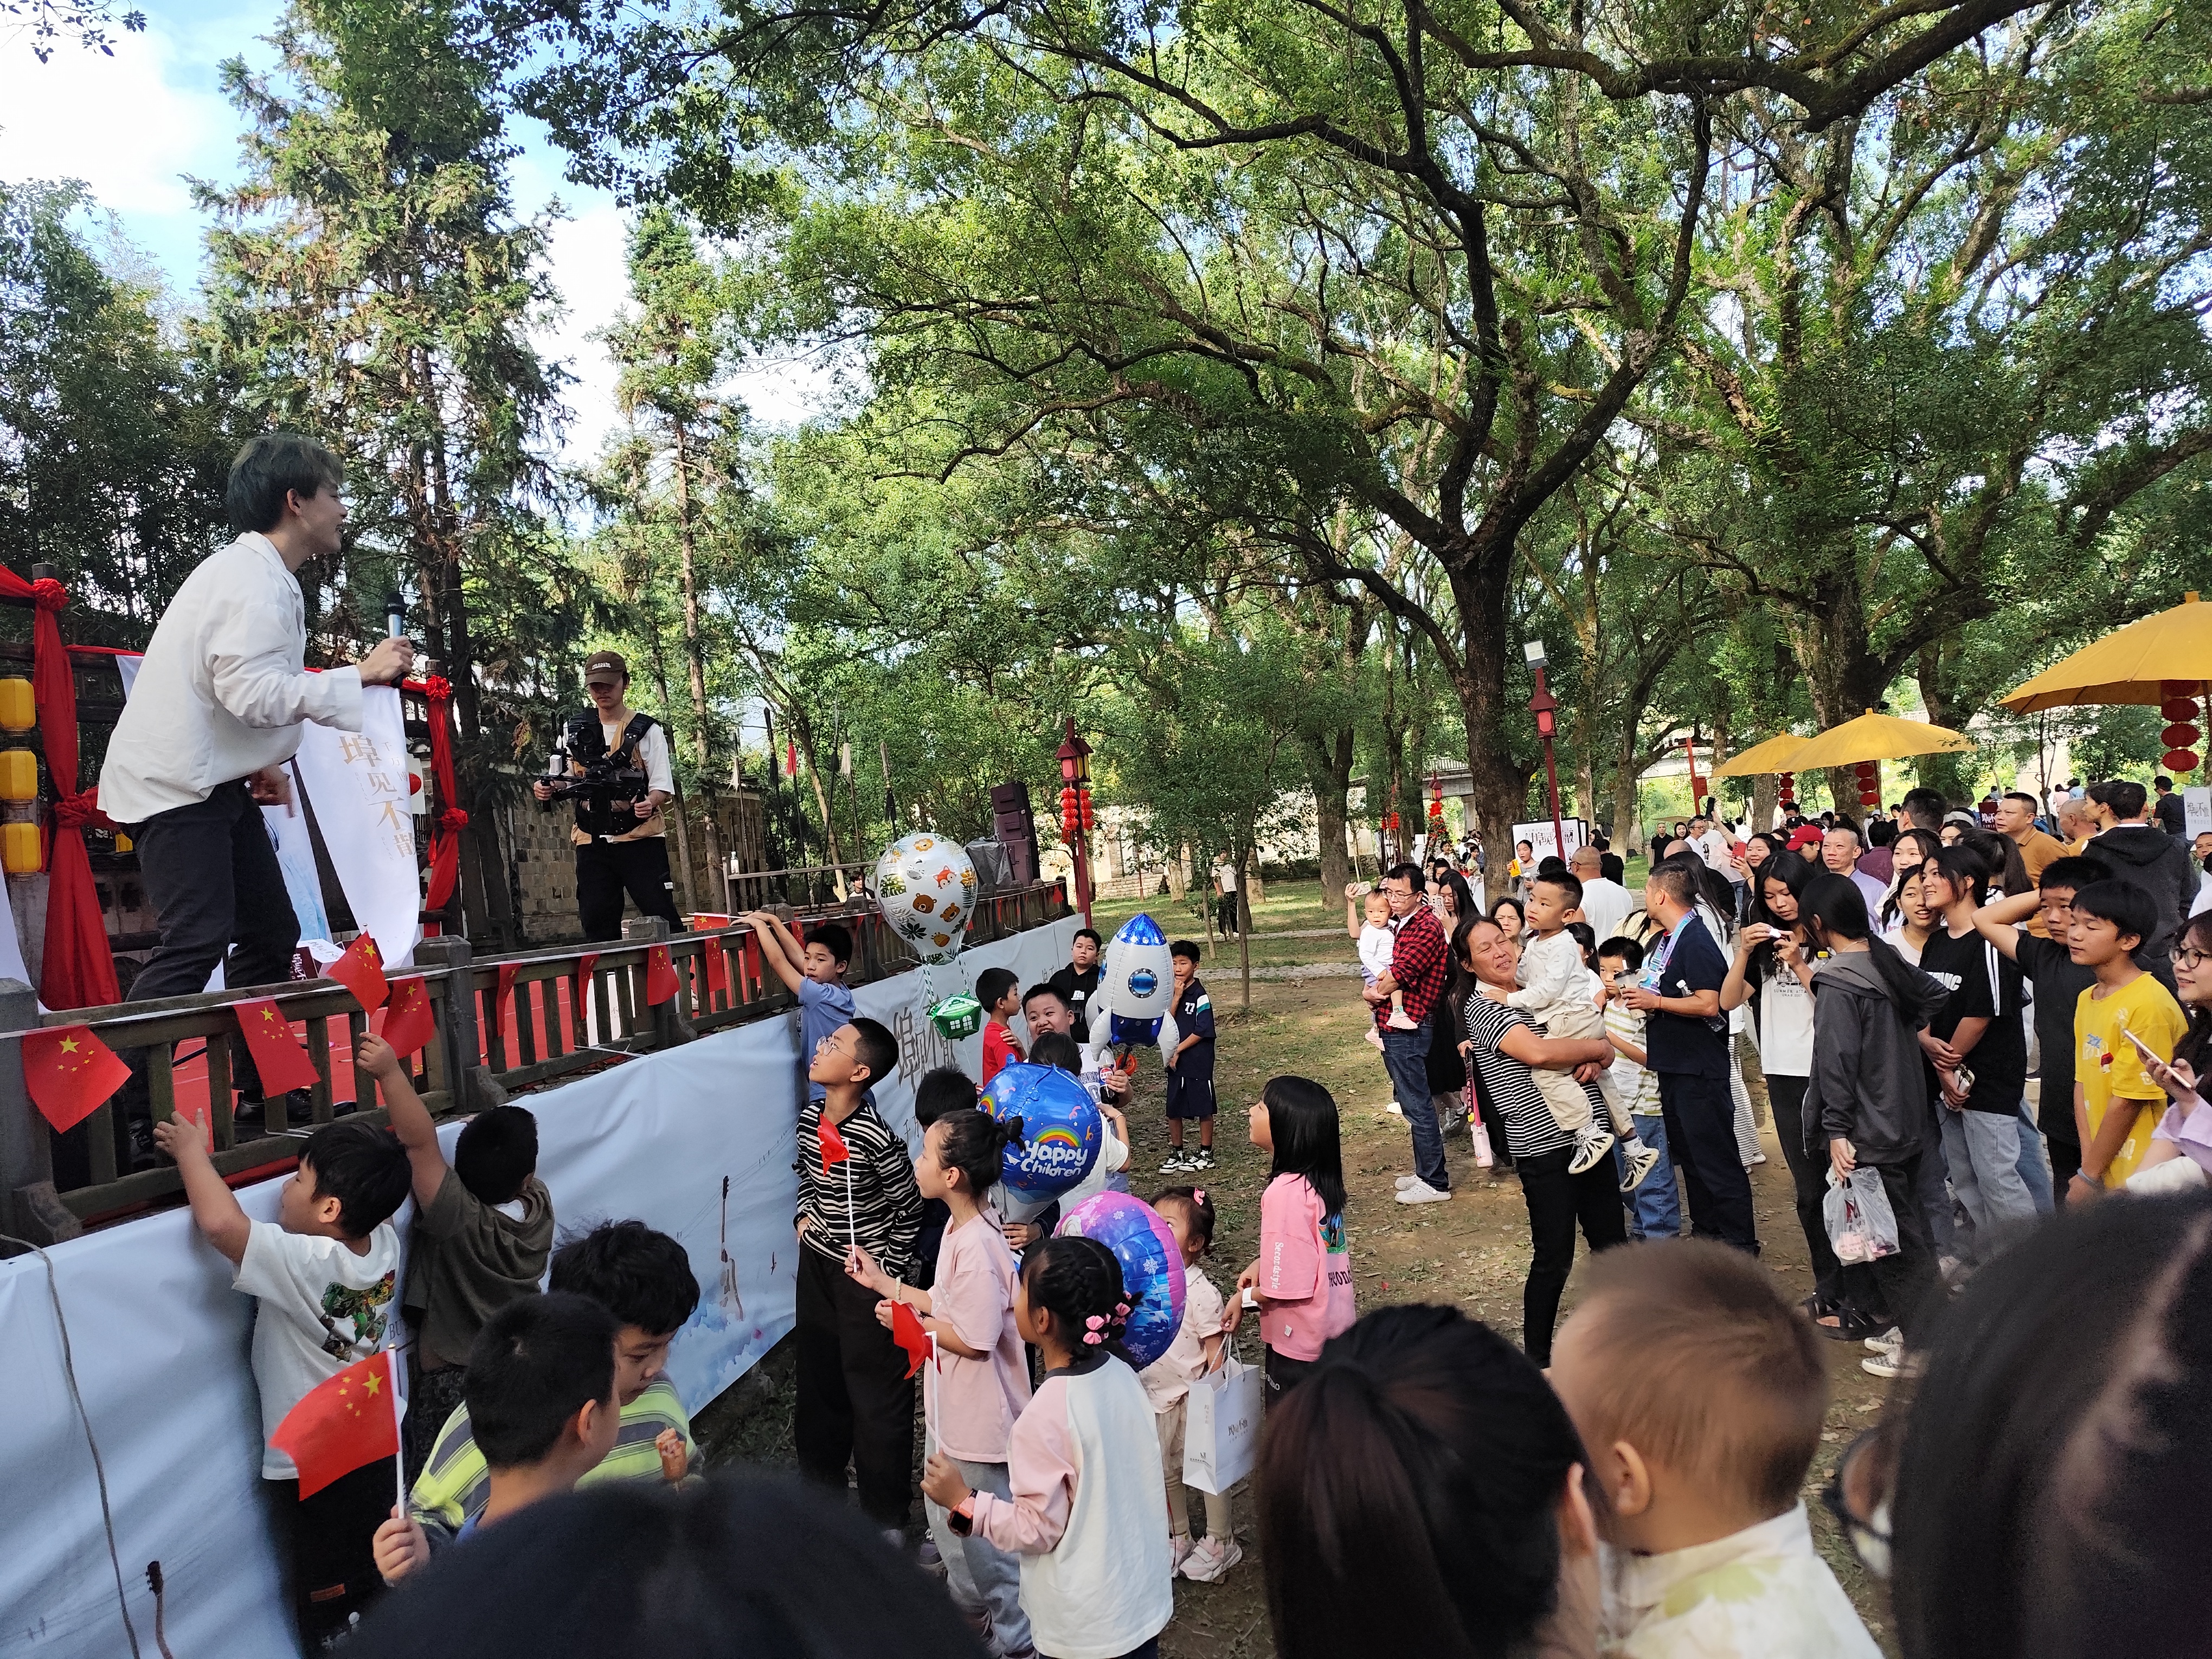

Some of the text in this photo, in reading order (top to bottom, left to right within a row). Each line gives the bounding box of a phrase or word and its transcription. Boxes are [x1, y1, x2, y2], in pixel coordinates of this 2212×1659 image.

[339, 734, 417, 858] 埠见不散
[1185, 1002, 1195, 1013] 77
[1020, 1140, 1088, 1167] Happy
[1020, 1158, 1082, 1176] Children
[1270, 1242, 1284, 1290] Secondstyle
